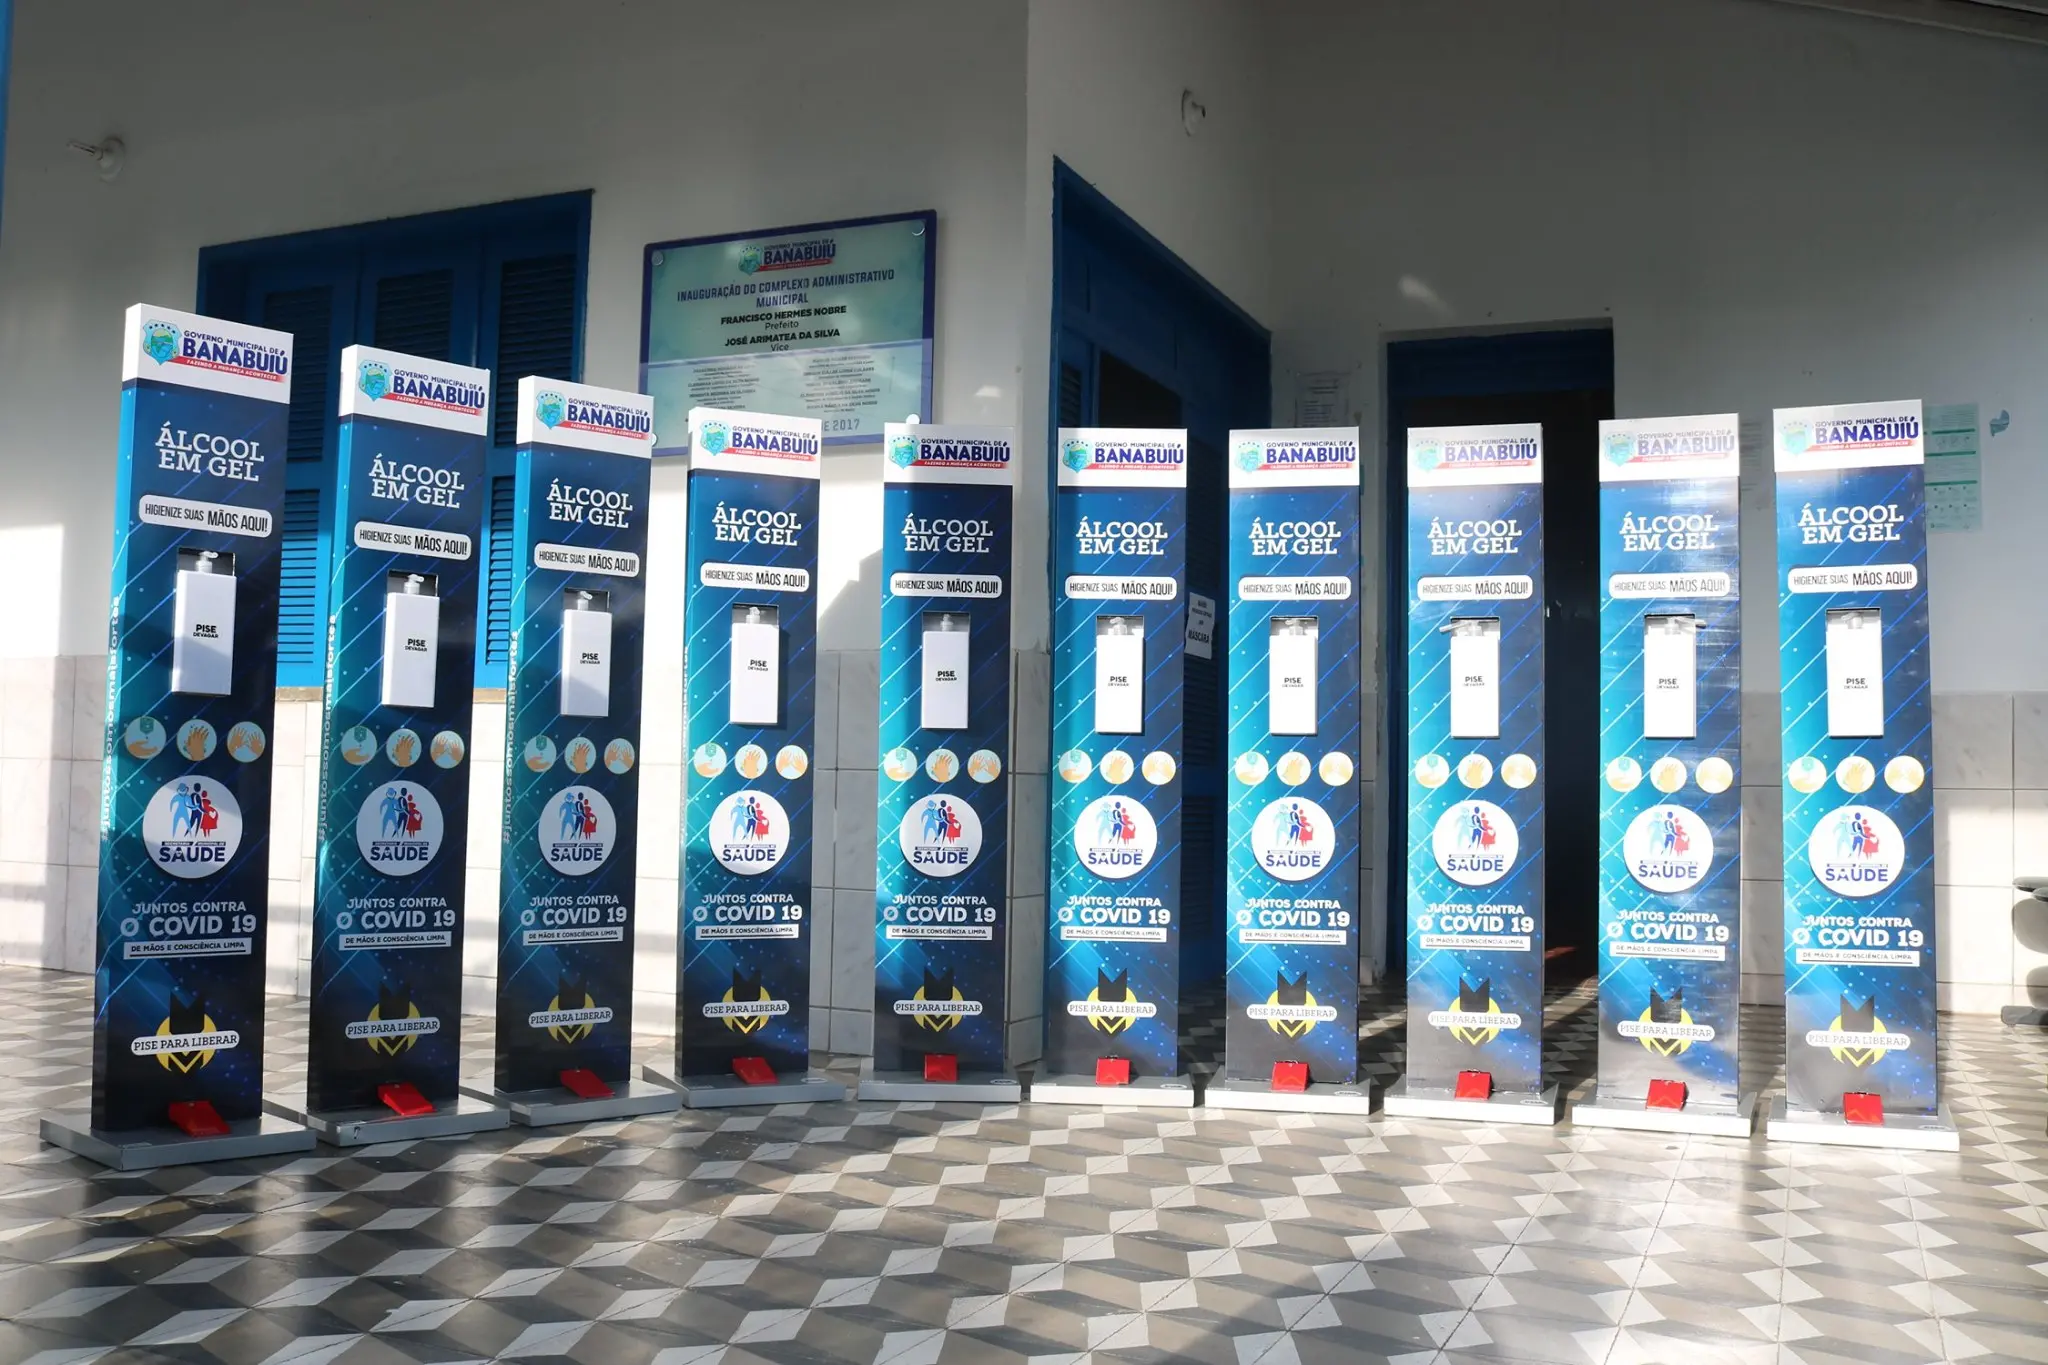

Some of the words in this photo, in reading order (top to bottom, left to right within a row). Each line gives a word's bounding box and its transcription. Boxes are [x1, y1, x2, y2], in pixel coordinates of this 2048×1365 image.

[764, 240, 836, 264] BANABUIÚ
[678, 284, 740, 302] INAUGURAÇÃO
[744, 284, 756, 294] DO
[759, 278, 809, 293] COMPLEXO
[812, 269, 894, 288] ADMINISTRATIVO
[756, 293, 808, 308] MUNICIPAL
[720, 313, 772, 324] FRANCISCO
[774, 309, 812, 319] HERMES
[814, 306, 846, 316] NOBRE
[765, 320, 799, 330] Prefeito
[184, 330, 222, 343] GOVERNO
[226, 339, 266, 352] MUNICIPAL
[725, 336, 748, 346] JOSÉ
[750, 333, 796, 344] ARIMATEA
[814, 329, 840, 338] SILVA
[182, 337, 287, 375] BANABUIÚ
[771, 343, 789, 352] Vice
[392, 375, 484, 408] BANABUIÚ
[567, 404, 649, 432] BANABUIÚ
[833, 419, 860, 431] 2017
[1814, 416, 1918, 443] BANABUIÚ
[154, 420, 266, 462] ÁLCOOL
[731, 432, 817, 454] BANABUIÚ
[1445, 438, 1536, 461] BANABUIÚ
[920, 442, 1009, 461] BANABUIÚ
[1094, 444, 1183, 463] BANABUIÚ
[1266, 441, 1355, 463] BANABUIÚ
[158, 448, 202, 473] EM
[208, 455, 260, 482] GEL
[368, 452, 465, 490] ÁLCOOL
[371, 478, 410, 501] EM
[415, 484, 461, 508] GEL
[546, 478, 633, 511] ÁLCOOL
[144, 502, 182, 518] HIGIENIZE
[183, 508, 204, 521] SUAS
[207, 508, 238, 528] MÃOS
[241, 514, 268, 532] AQUI!
[549, 502, 583, 523] EM
[588, 507, 629, 528] GEL
[711, 501, 801, 529] ÁLCOOL
[1619, 511, 1718, 534] ÁLCOOL
[1797, 503, 1904, 526] ÁLCOOL
[901, 513, 993, 536] ÁLCOOL
[1075, 516, 1168, 538] ÁLCOOL
[1248, 517, 1341, 538] ÁLCOOL
[1427, 516, 1522, 538] ÁLCOOL
[1802, 525, 1842, 544] EM
[1849, 523, 1900, 542] GEL
[715, 524, 750, 542] EM
[755, 527, 798, 546] GEL
[904, 535, 940, 551] EM
[946, 536, 989, 552] GEL
[1623, 534, 1661, 552] EM
[1667, 532, 1715, 550] GEL
[1079, 538, 1114, 554] EM
[1120, 539, 1164, 554] GEL
[1252, 539, 1287, 555] EM
[1293, 538, 1337, 554] GEL
[1431, 538, 1467, 555] EM
[1473, 537, 1518, 554] GEL
[704, 569, 734, 580] HIGIENIZE
[736, 572, 753, 581] SUAS
[756, 570, 780, 585] MÃOS
[783, 573, 805, 587] AQUI!
[196, 624, 216, 634] PISE
[131, 902, 187, 915] JUNTOS
[192, 900, 247, 912] CONTRA
[346, 897, 395, 909] JUNTOS
[399, 897, 447, 907] CONTRA
[529, 895, 573, 907] JUNTOS
[576, 894, 619, 904] CONTRA
[701, 894, 746, 904] JUNTOS
[750, 893, 794, 902] CONTRA
[892, 895, 937, 904] JUNTOS
[941, 896, 987, 904] CONTRA
[1066, 896, 1111, 905] JUNTOS
[1115, 897, 1161, 906] CONTRA
[1245, 898, 1290, 907] JUNTOS
[1294, 900, 1340, 909] CONTRA
[542, 905, 600, 926] COVID
[606, 905, 627, 922] 19
[715, 904, 775, 922] COVID
[781, 904, 802, 920] 19
[906, 906, 967, 921] COVID
[974, 907, 996, 922] 19
[1080, 907, 1141, 923] COVID
[1148, 909, 1170, 924] 19
[1426, 904, 1472, 913] JUNTOS
[1476, 905, 1523, 913] CONTRA
[1616, 910, 1664, 920] JUNTOS
[1669, 912, 1718, 922] CONTRA
[148, 913, 223, 936] COVID
[231, 913, 257, 933] 19
[360, 909, 426, 929] COVID
[433, 909, 456, 927] 19
[1259, 910, 1320, 926] COVID
[1328, 912, 1350, 927] 19
[1440, 915, 1503, 931] COVID
[1511, 916, 1533, 932] 19
[1802, 916, 1853, 926] JUNTOS
[1858, 917, 1912, 927] CONTRA
[1631, 923, 1697, 940] COVID
[1705, 925, 1729, 942] 19
[1818, 928, 1889, 945] COVID
[1897, 930, 1923, 947] 19
[143, 943, 164, 951] MÃOS
[173, 940, 221, 950] CONSCIÊNCIA
[942, 1004, 980, 1012] LIBERAR
[133, 1039, 157, 1051] PISE
[160, 1037, 189, 1049] PARA
[191, 1033, 237, 1046] LIBERAR
